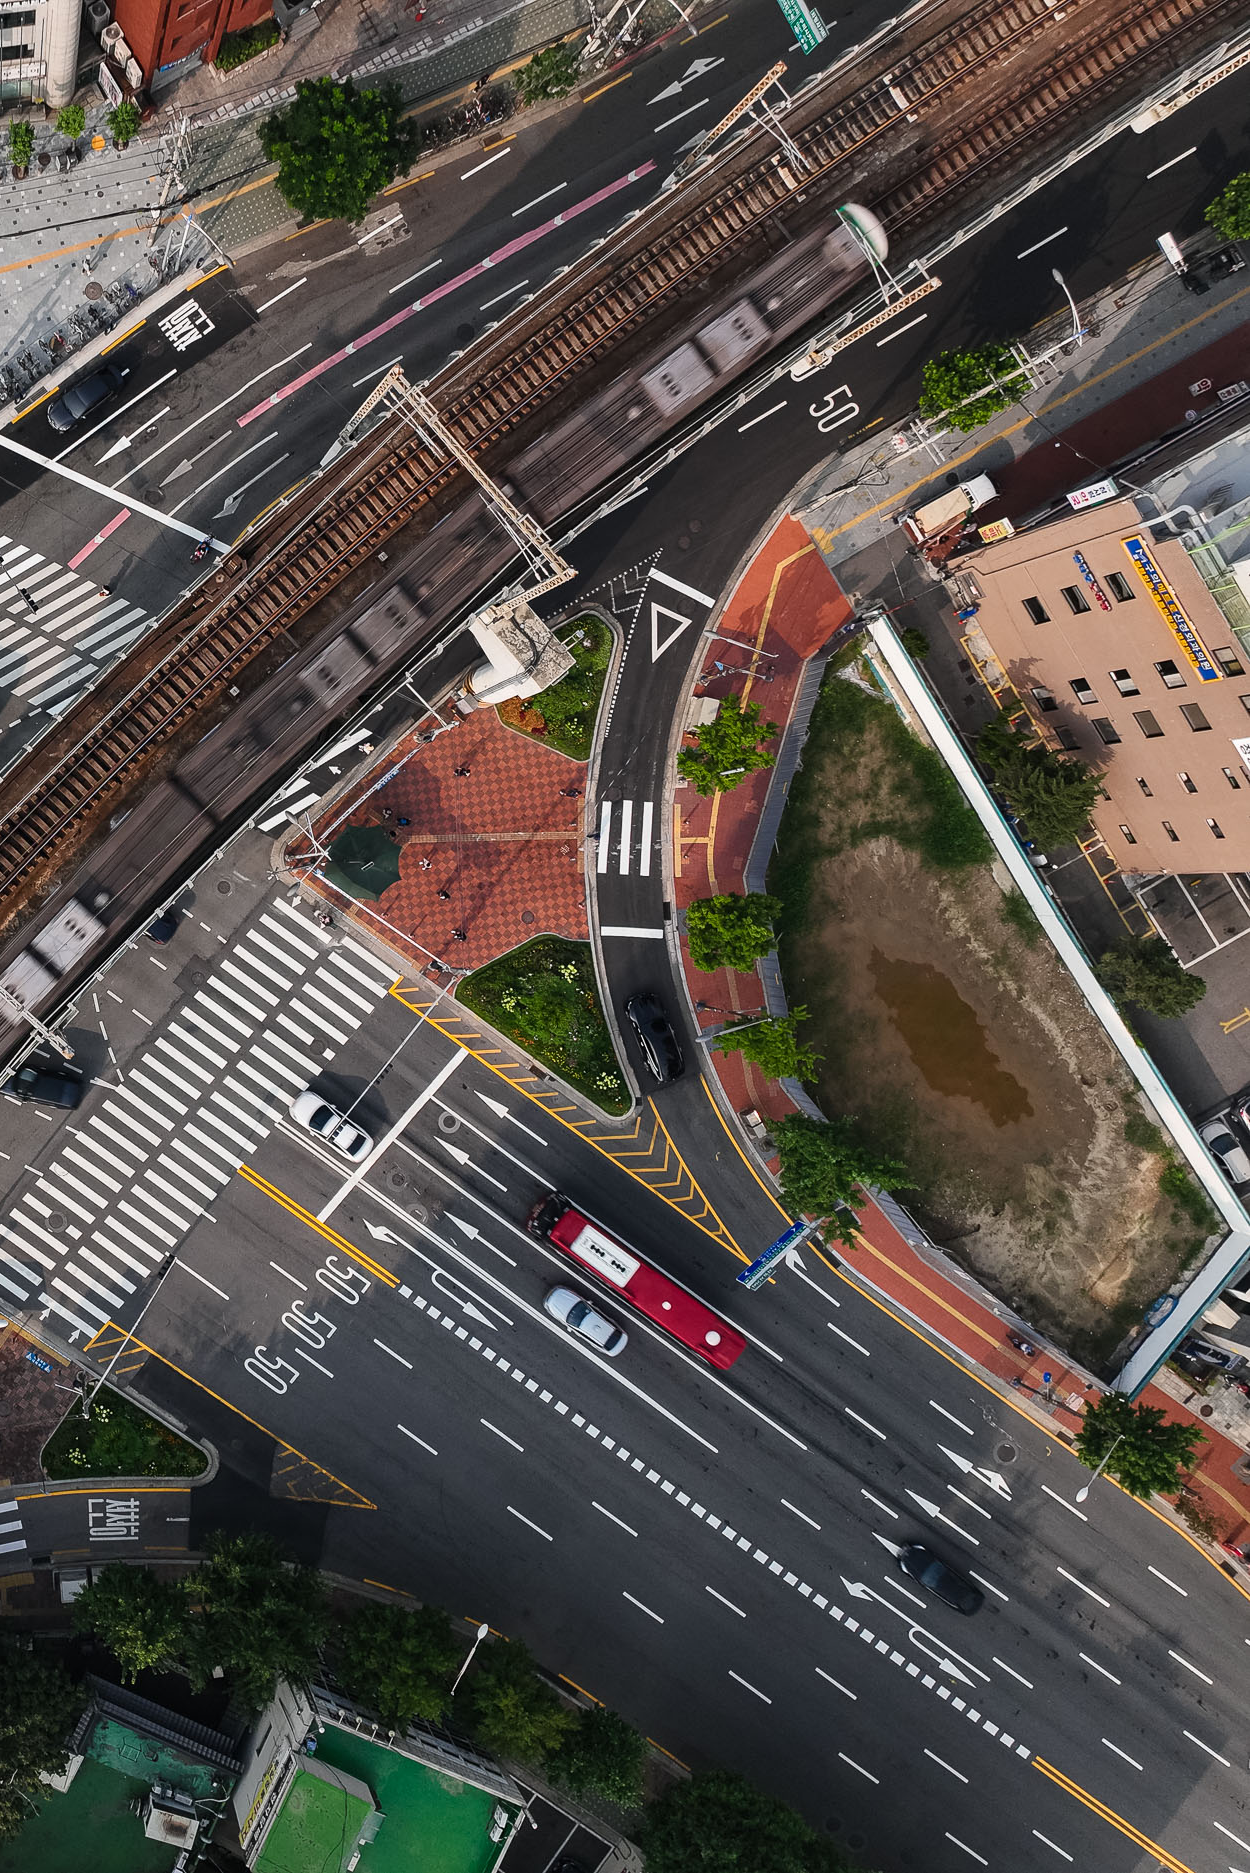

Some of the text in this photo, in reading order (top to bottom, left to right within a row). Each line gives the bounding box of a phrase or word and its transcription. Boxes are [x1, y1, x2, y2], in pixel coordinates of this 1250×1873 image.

[159, 298, 214, 351] 천천히
[809, 385, 859, 433] 50
[316, 1256, 371, 1305] 50
[281, 1300, 337, 1349] 50
[244, 1345, 300, 1395] 50
[89, 1498, 139, 1540] 천천히
